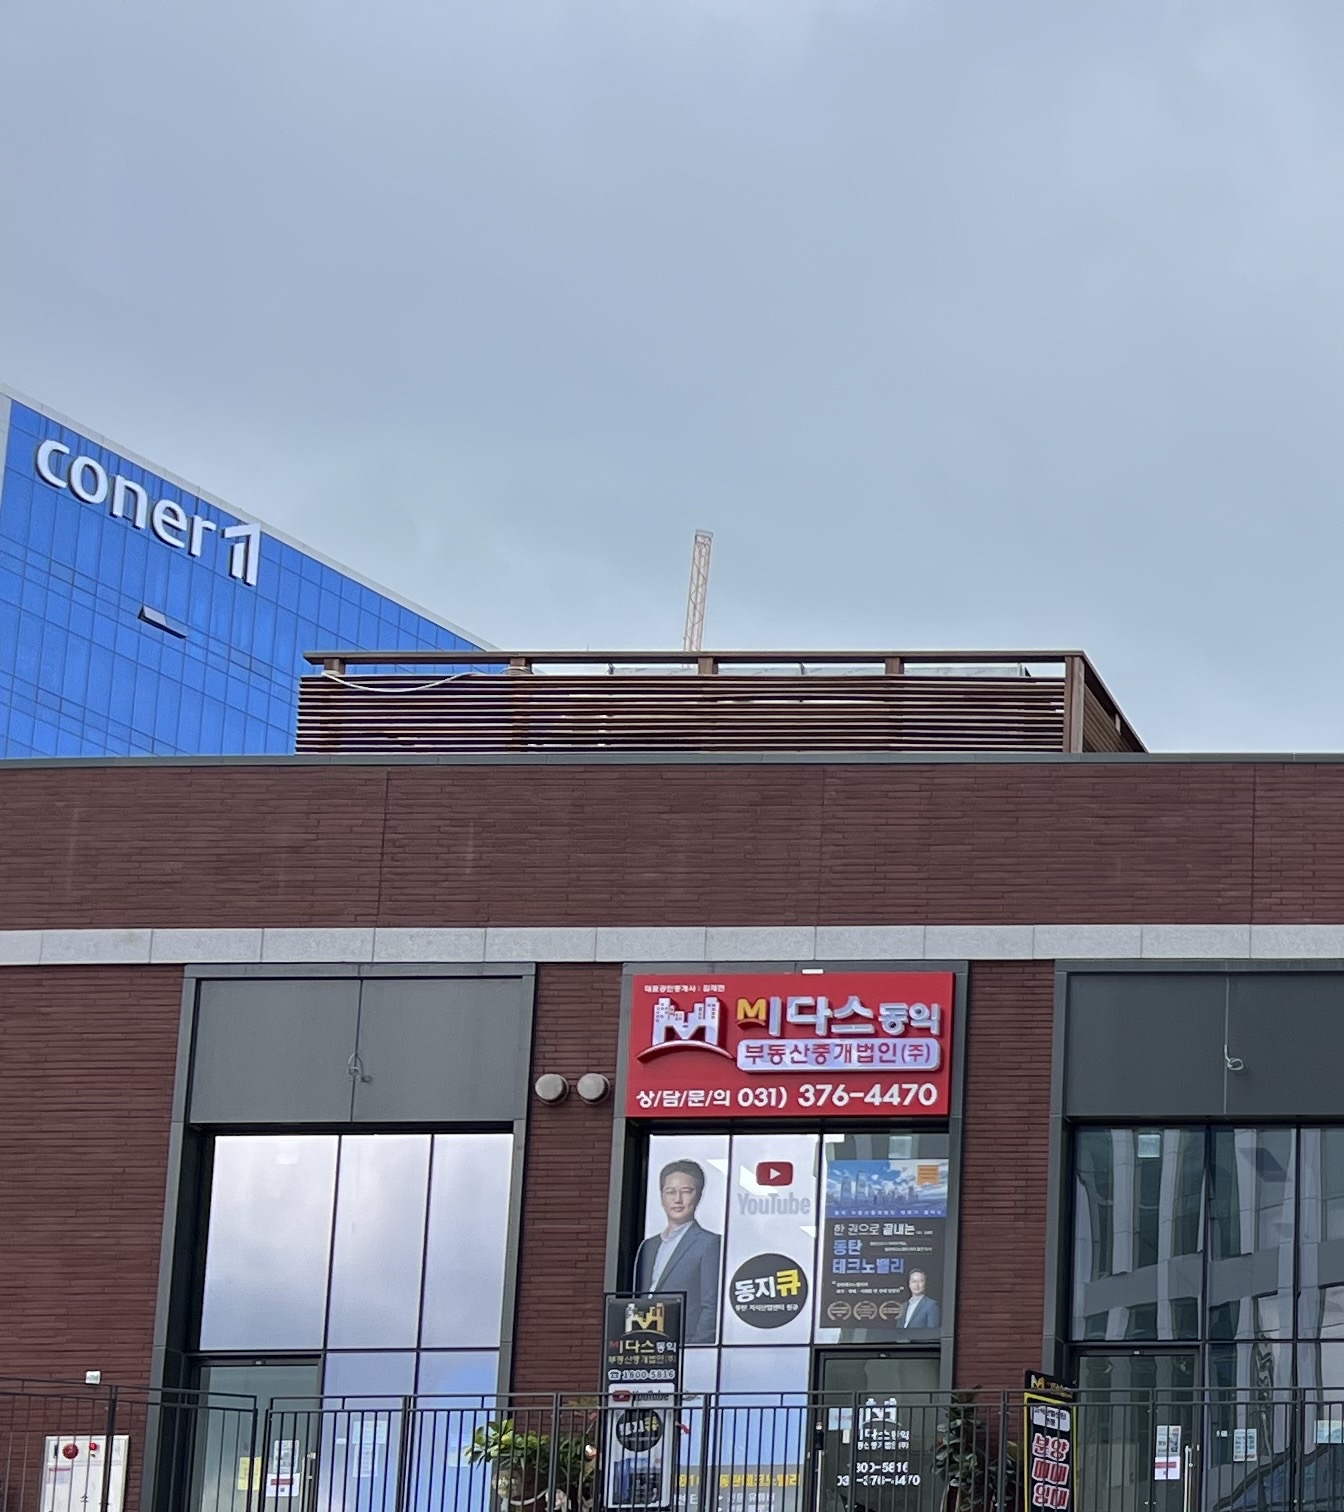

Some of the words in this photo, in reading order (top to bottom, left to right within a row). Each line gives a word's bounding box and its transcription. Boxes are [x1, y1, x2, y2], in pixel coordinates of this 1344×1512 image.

[737, 1087, 788, 1109] 031)
[797, 1083, 938, 1107] 376-4470
[737, 1192, 811, 1215] YouTube
[735, 1269, 801, 1303] 동지큐
